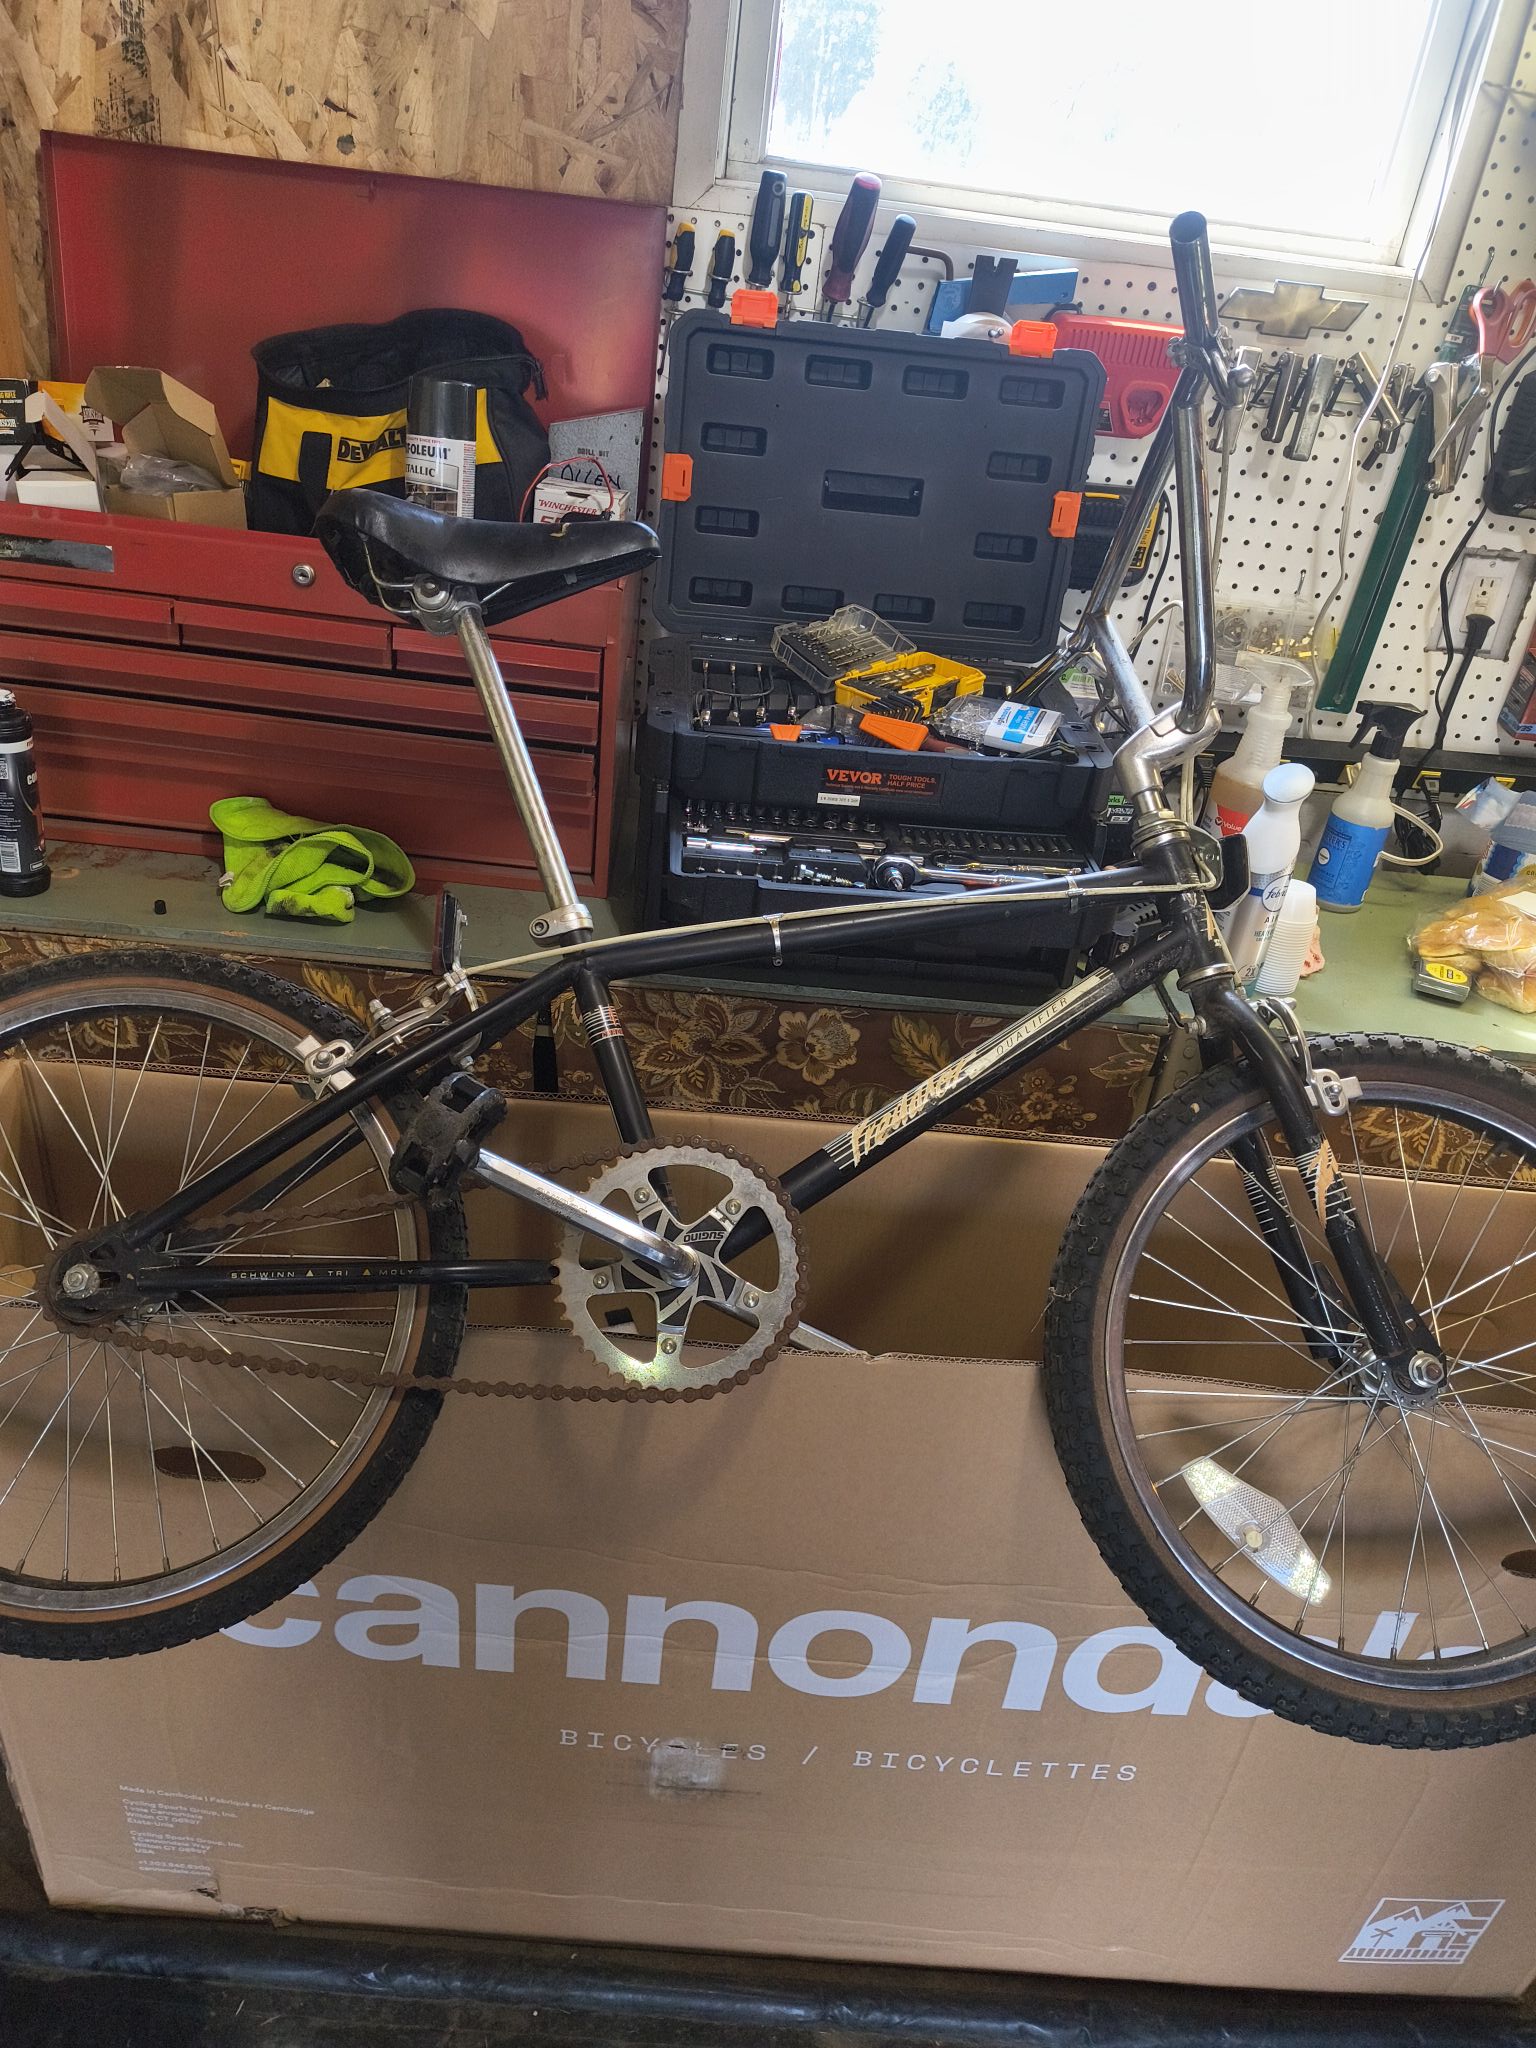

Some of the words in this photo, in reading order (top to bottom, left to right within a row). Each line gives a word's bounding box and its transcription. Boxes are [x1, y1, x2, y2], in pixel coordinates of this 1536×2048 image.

[337, 425, 407, 461] DEWALT
[598, 450, 610, 458] BIT
[538, 499, 598, 516] WINCHESTER
[826, 768, 883, 785] VEVOR
[913, 775, 937, 785] TOOLS,
[905, 781, 926, 789] PRICE
[996, 996, 1069, 1056] QUALIFIER
[683, 1231, 725, 1243] SUGINO
[231, 1271, 296, 1279] SCHWINN
[327, 1269, 349, 1277] TRI
[218, 1574, 1487, 1718] cannond
[559, 1728, 767, 1761] BICYCLES
[852, 1749, 1138, 1782] BICYCLETTES
[119, 1785, 145, 1794] Made
[157, 1789, 203, 1801] Cambodia
[264, 1804, 315, 1815] Cambodge
[158, 1803, 188, 1812] Sports
[165, 1833, 194, 1842] Sports
